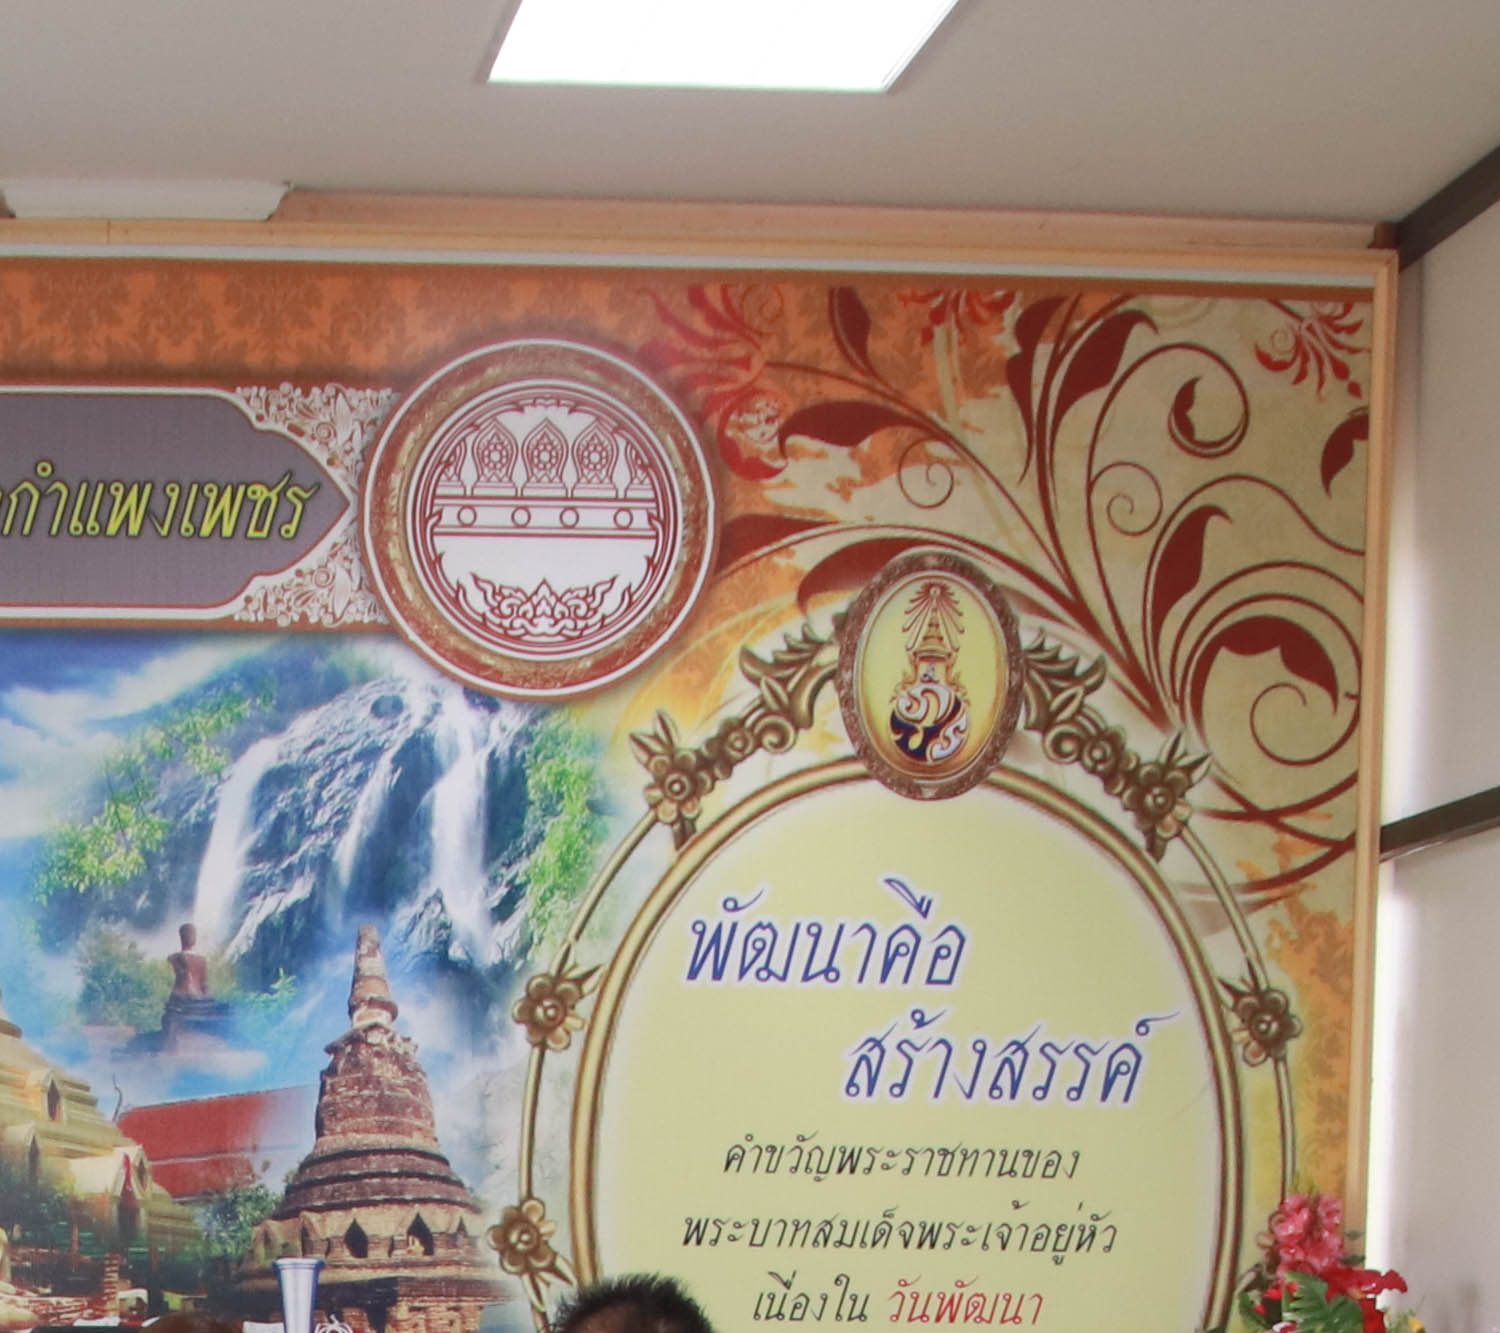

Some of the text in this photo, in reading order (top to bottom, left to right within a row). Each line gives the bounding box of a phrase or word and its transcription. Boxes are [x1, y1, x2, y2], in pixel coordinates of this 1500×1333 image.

[686, 876, 967, 987] พัฒนาคือ
[844, 1007, 1181, 1104] สร้างสรรค์
[723, 1130, 1081, 1183] คำขวัญพระราชทานของ
[681, 1199, 1118, 1266] พระบาทสมเด็จพระเจ้าอยู่หัว
[752, 1270, 1044, 1327] เนื่องใน วันพัฒนา
